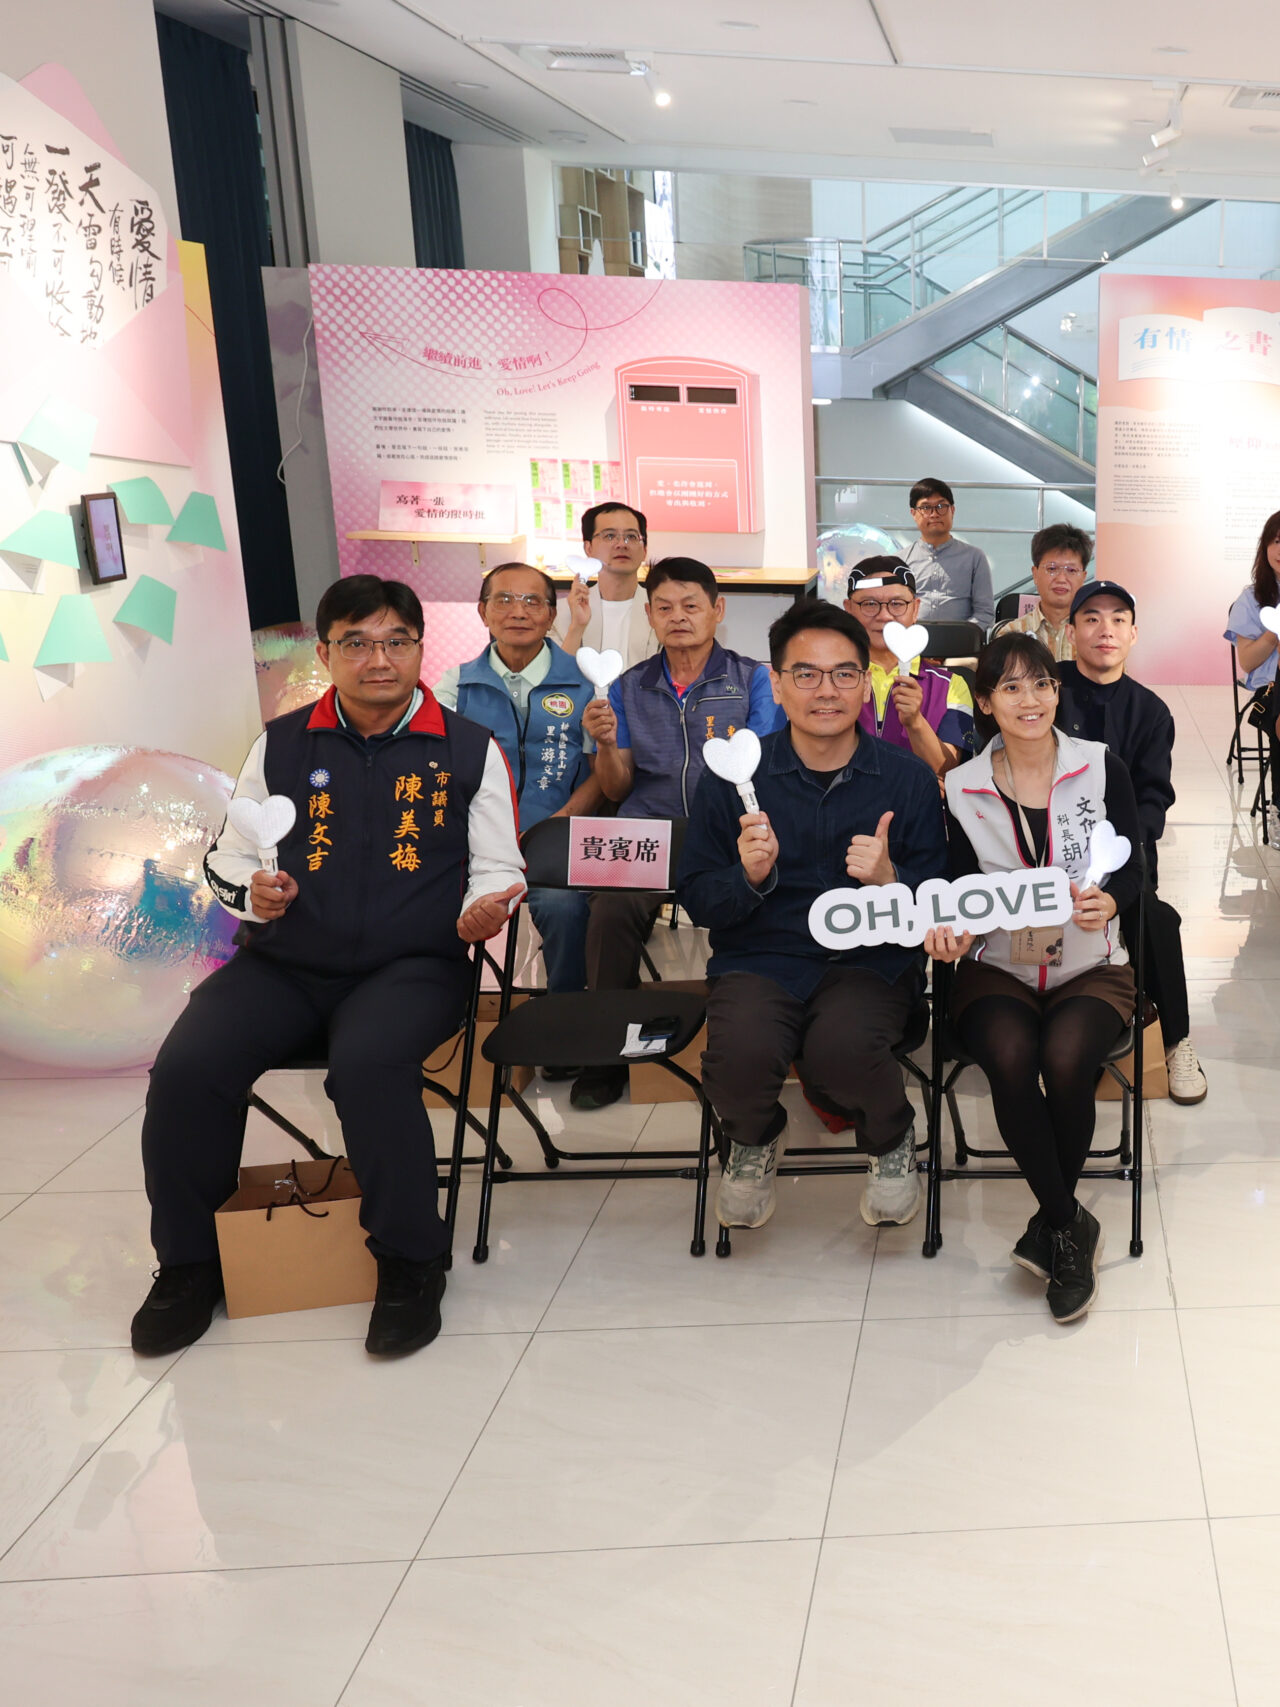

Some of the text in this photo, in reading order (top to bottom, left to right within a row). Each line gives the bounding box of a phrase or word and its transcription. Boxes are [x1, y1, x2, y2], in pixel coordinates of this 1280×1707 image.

[130, 198, 162, 311] 愛情
[496, 387, 513, 396] Oh,
[514, 385, 536, 395] Love!
[537, 382, 557, 392] Let's
[558, 374, 577, 387] Keep
[389, 772, 424, 872] 陳美梅
[431, 770, 451, 827] 市議員
[306, 791, 335, 872] 陳文吉
[580, 836, 660, 863] 貴賓席
[824, 881, 1058, 934] OH, LOVE
